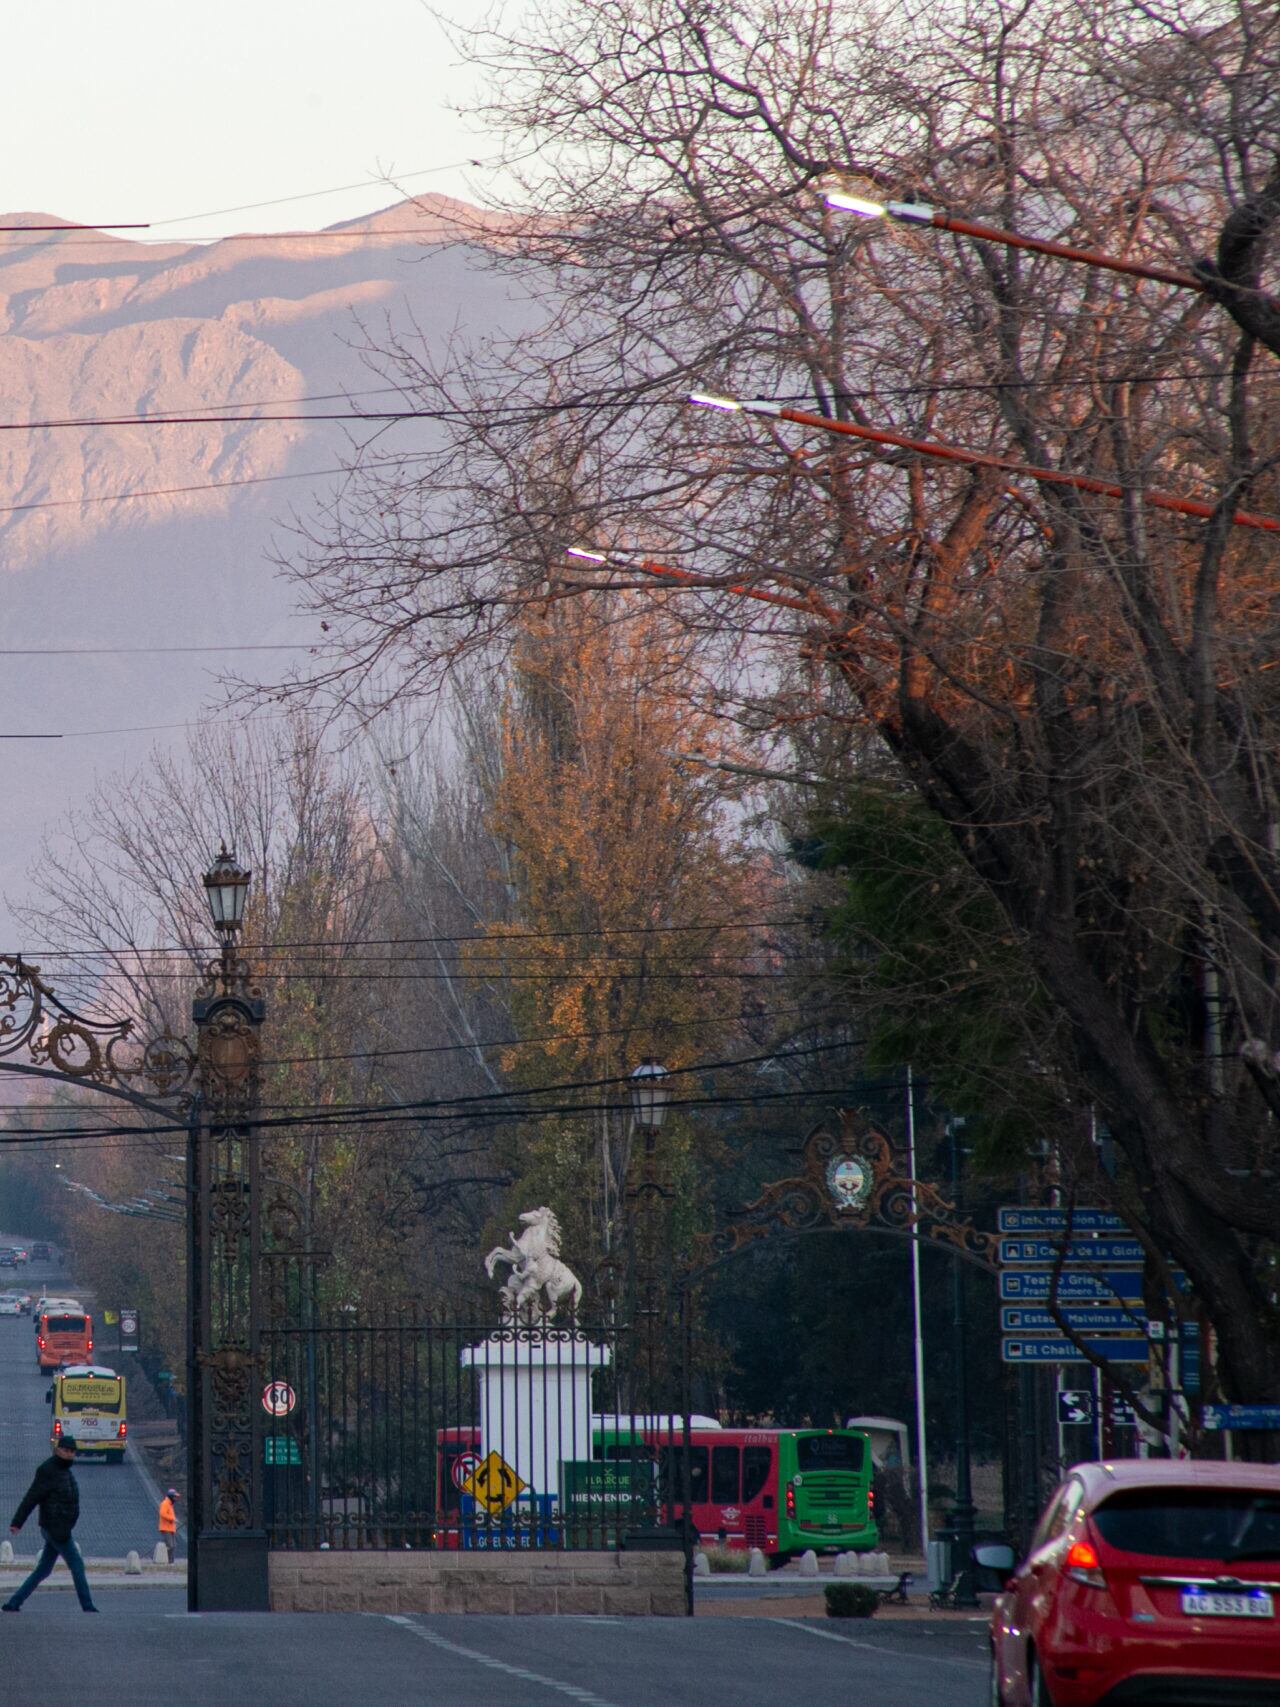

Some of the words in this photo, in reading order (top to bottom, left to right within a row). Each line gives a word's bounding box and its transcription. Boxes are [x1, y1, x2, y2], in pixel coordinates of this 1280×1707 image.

[1023, 1274, 1065, 1285] Teato
[1068, 1314, 1117, 1324] Malvinas
[1025, 1345, 1038, 1356] El
[1041, 1345, 1085, 1356] Challa
[270, 1388, 290, 1404] 60
